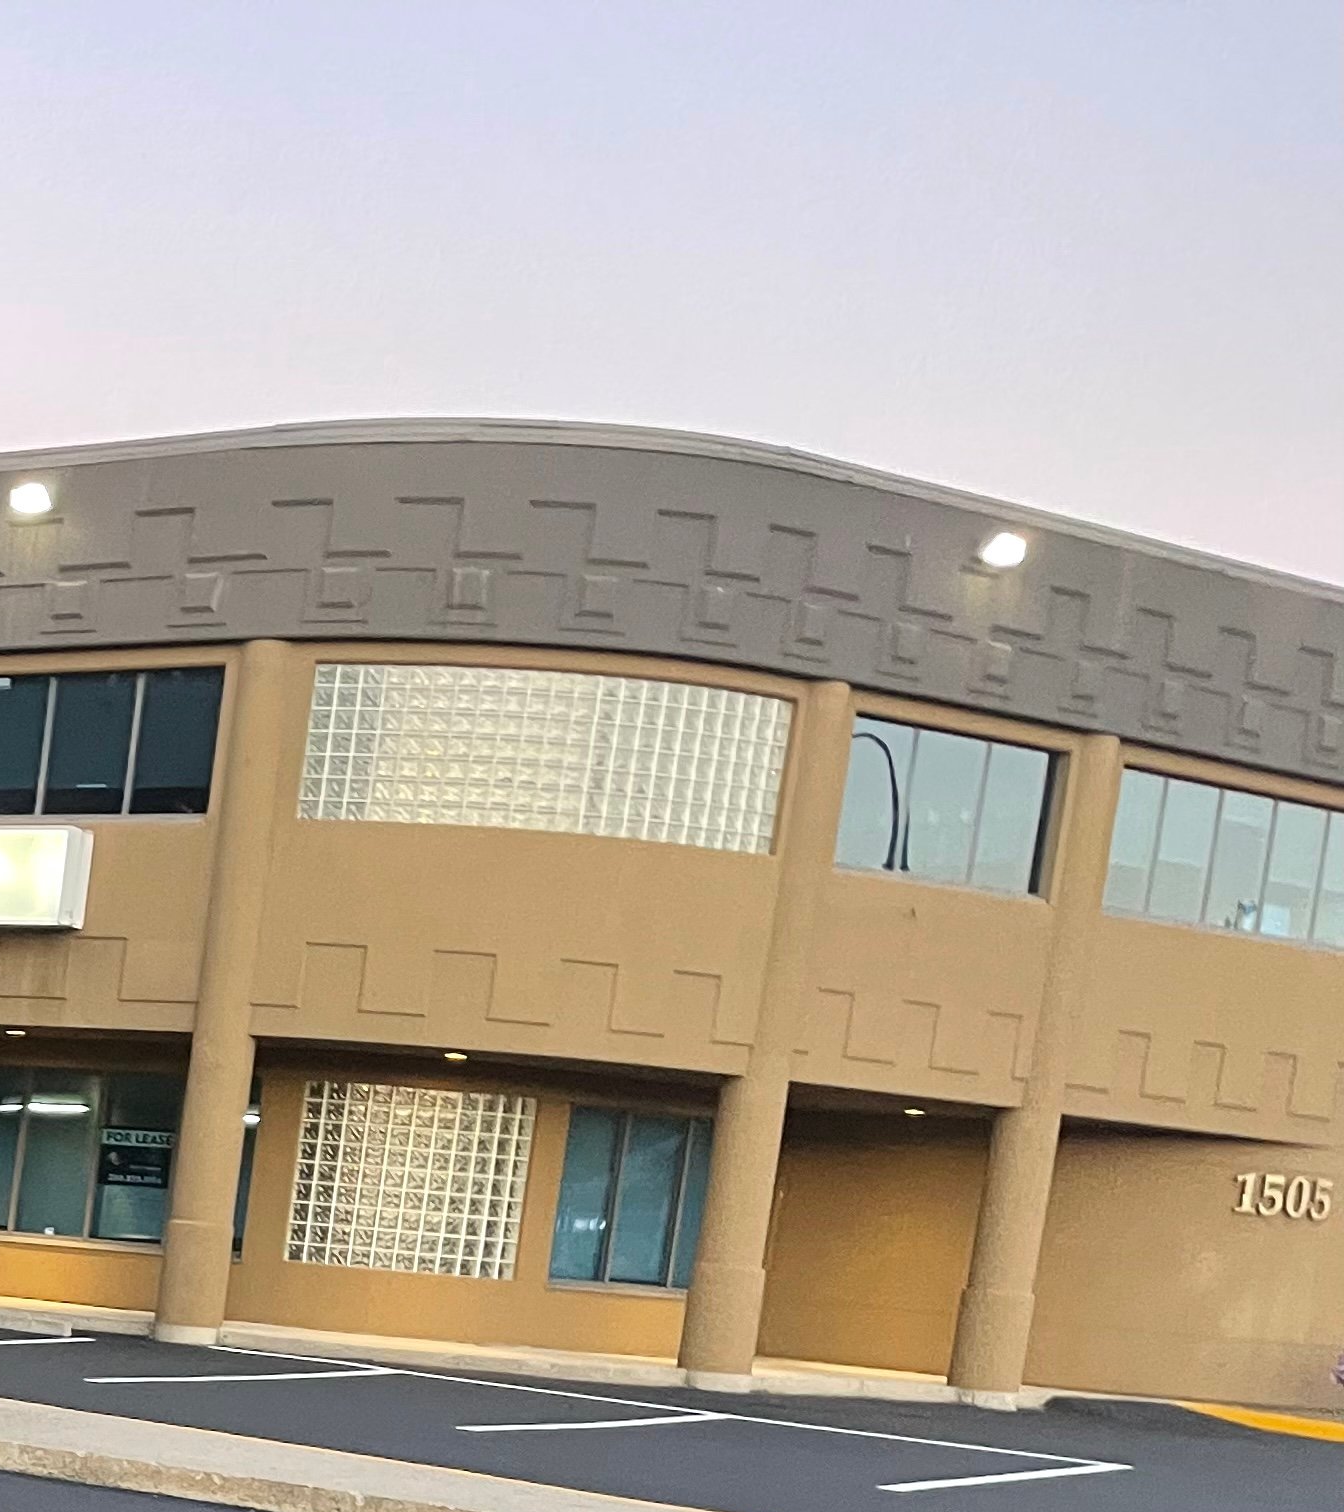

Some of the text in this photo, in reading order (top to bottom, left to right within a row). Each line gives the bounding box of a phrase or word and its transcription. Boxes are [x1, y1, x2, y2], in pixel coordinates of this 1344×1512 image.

[106, 1131, 174, 1146] FOR LEASE
[1233, 1172, 1334, 1221] 1505
